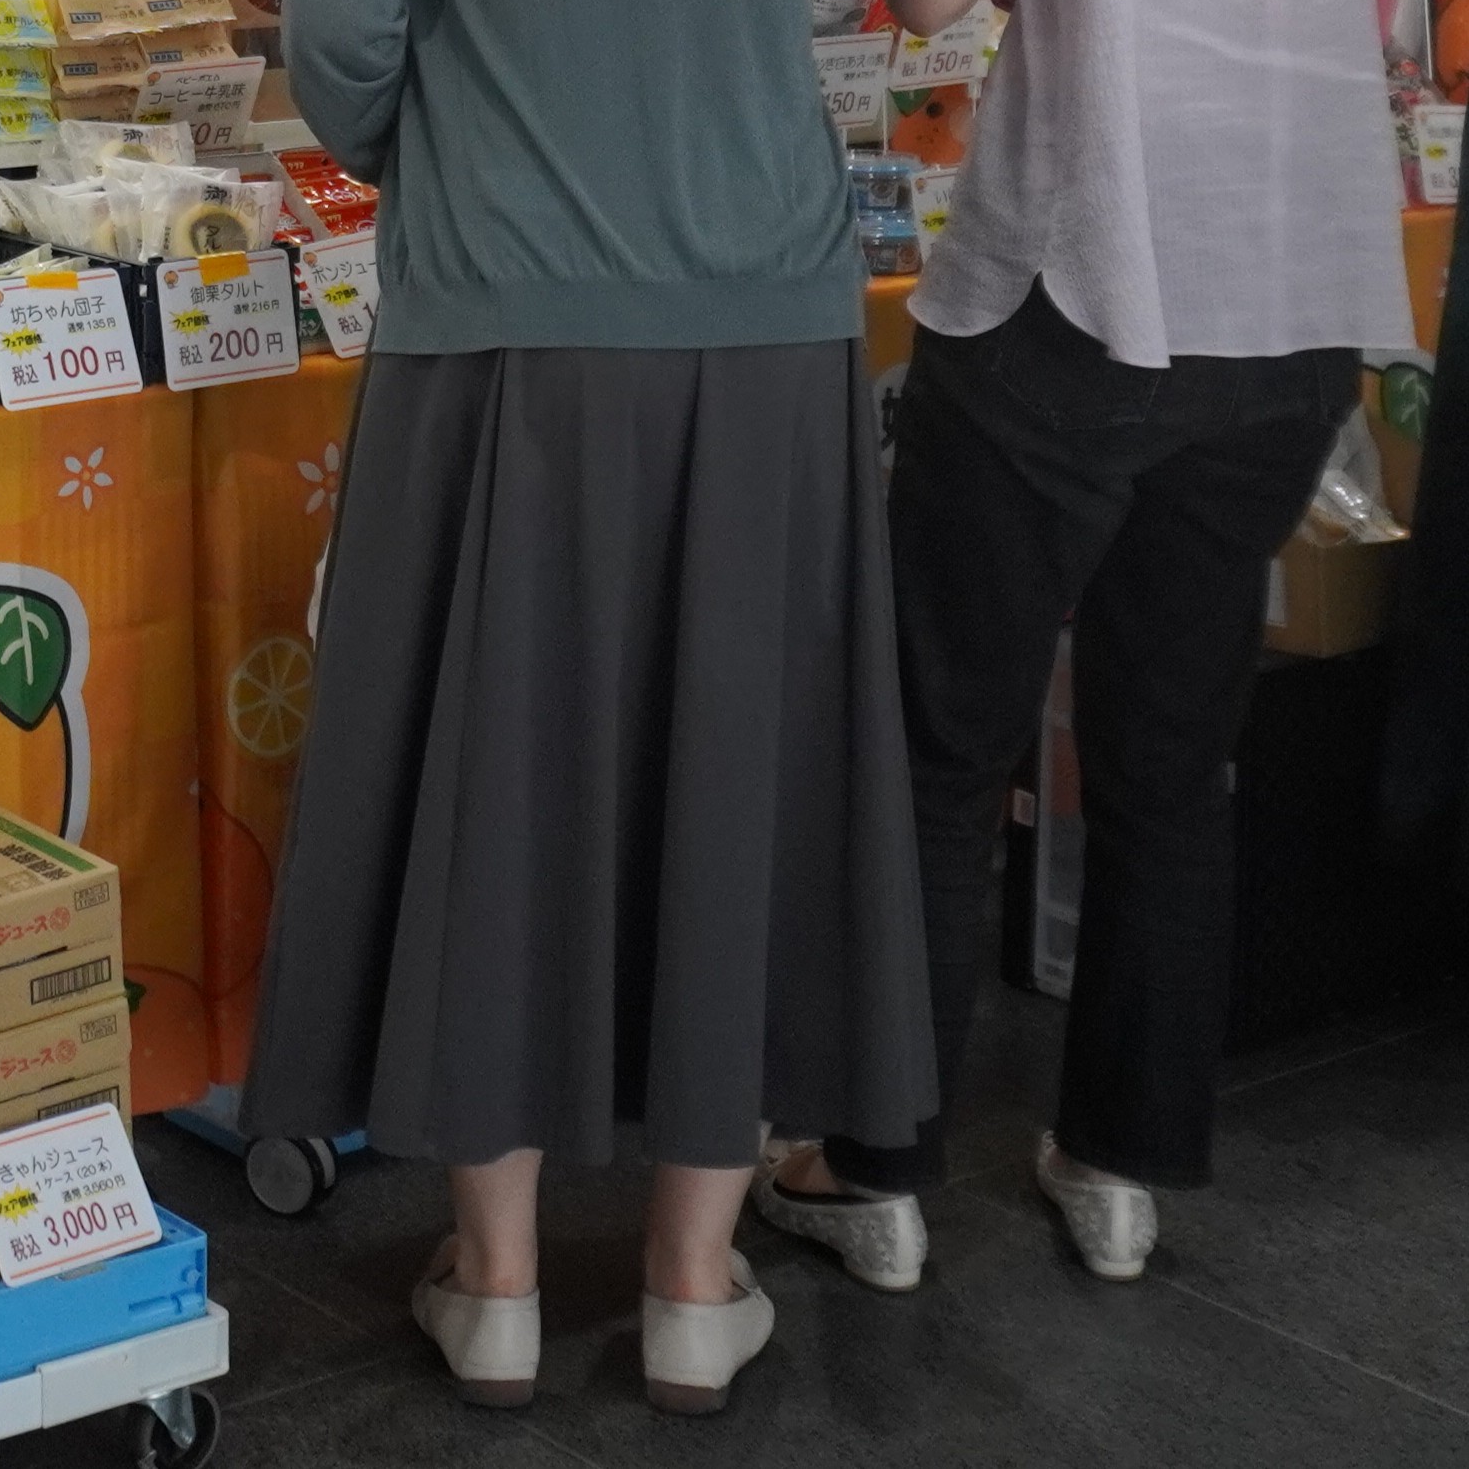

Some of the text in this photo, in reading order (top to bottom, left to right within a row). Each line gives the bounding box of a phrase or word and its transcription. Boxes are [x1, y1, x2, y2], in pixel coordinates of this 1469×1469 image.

[923, 50, 974, 74] 150 円
[149, 82, 248, 106] コーヒー牛乳味
[856, 93, 872, 112] 円
[214, 125, 233, 145] 円
[189, 281, 265, 306] 御栗タルト
[323, 287, 360, 304] フェア価格
[9, 295, 107, 326] 坊ちゃん団子
[172, 313, 211, 330] フェア価格
[337, 314, 364, 336] 税込
[1, 332, 44, 349] フェア価格
[178, 327, 284, 367] 税込 200 円
[11, 345, 126, 386] 税込 100 円
[10, 1200, 139, 1263] 税込 3,000 円
